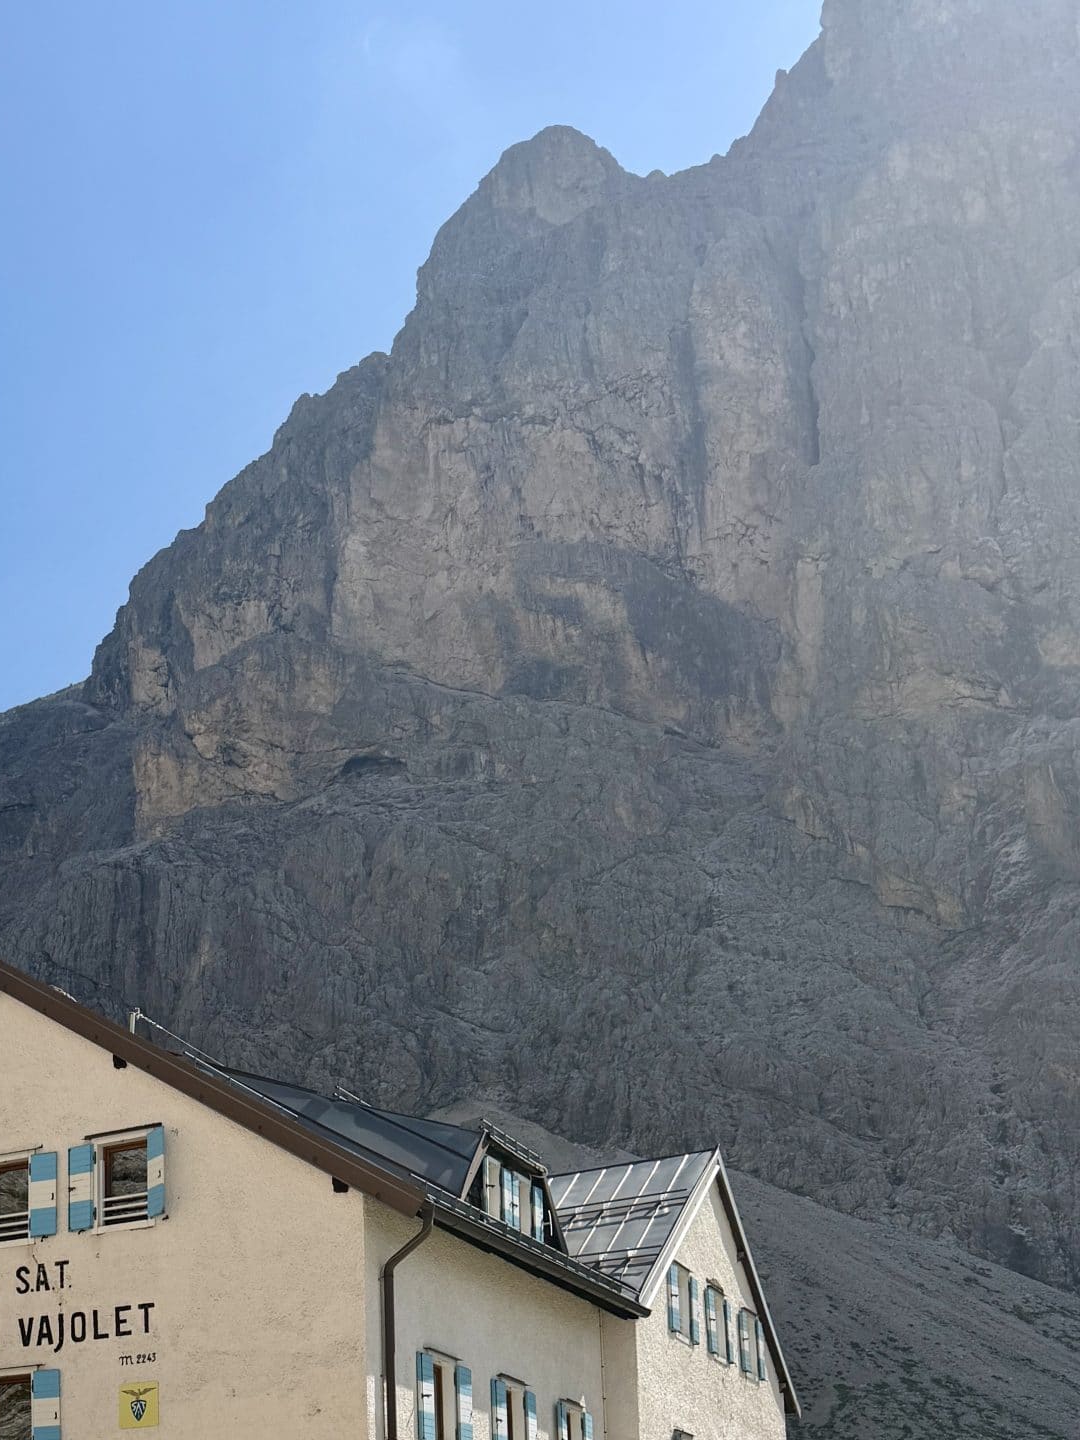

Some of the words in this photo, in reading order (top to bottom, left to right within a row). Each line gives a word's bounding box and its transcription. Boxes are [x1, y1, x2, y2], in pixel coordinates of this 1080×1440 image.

[15, 1259, 72, 1294] S.A.T.
[18, 1302, 155, 1353] VAJOLET
[136, 1352, 157, 1364] 2243
[131, 1401, 147, 1416] SAT
